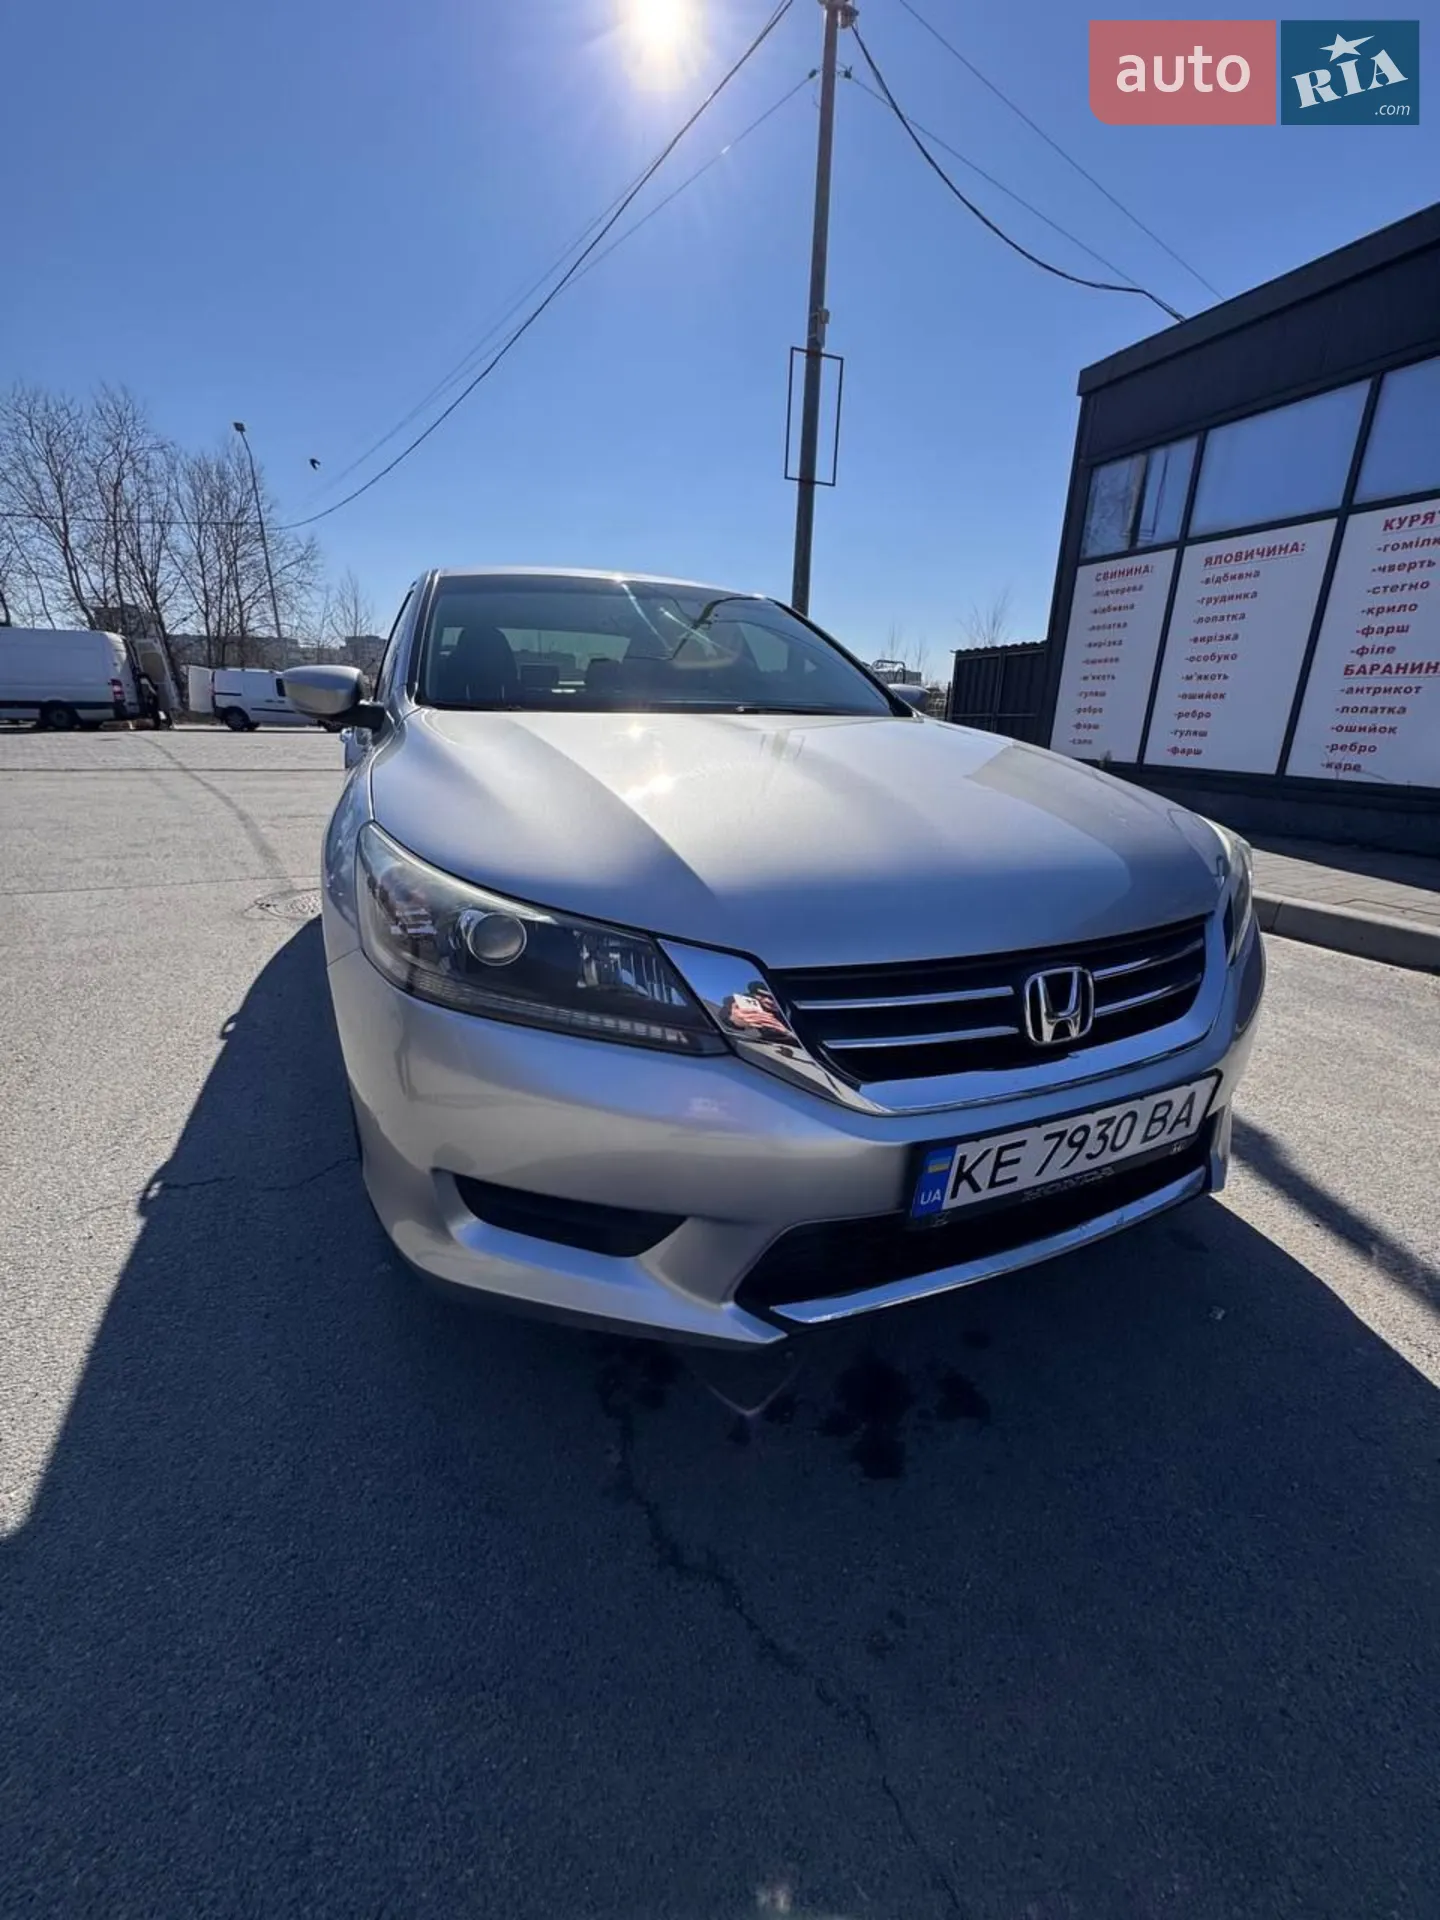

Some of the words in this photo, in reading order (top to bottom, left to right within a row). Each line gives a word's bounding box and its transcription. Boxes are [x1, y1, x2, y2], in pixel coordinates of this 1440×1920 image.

[1382, 509, 1440, 532] КУРЯ
[1204, 541, 1306, 567] ЯЛОВИЧИНА:
[1366, 579, 1430, 596] -стегно
[1361, 601, 1418, 617] -крило
[1356, 623, 1410, 638] -фарш
[1350, 644, 1397, 658] -філе
[1343, 661, 1440, 676] БАРАНИН
[1339, 684, 1423, 697] -антрикот
[1335, 704, 1408, 716] -лопатка
[1331, 722, 1399, 735] -ошийок
[1325, 741, 1378, 755] -ребро
[950, 1139, 1027, 1200] KE
[1035, 1110, 1138, 1178] 7930
[1140, 1091, 1196, 1145] BA
[920, 1187, 942, 1206] UA
